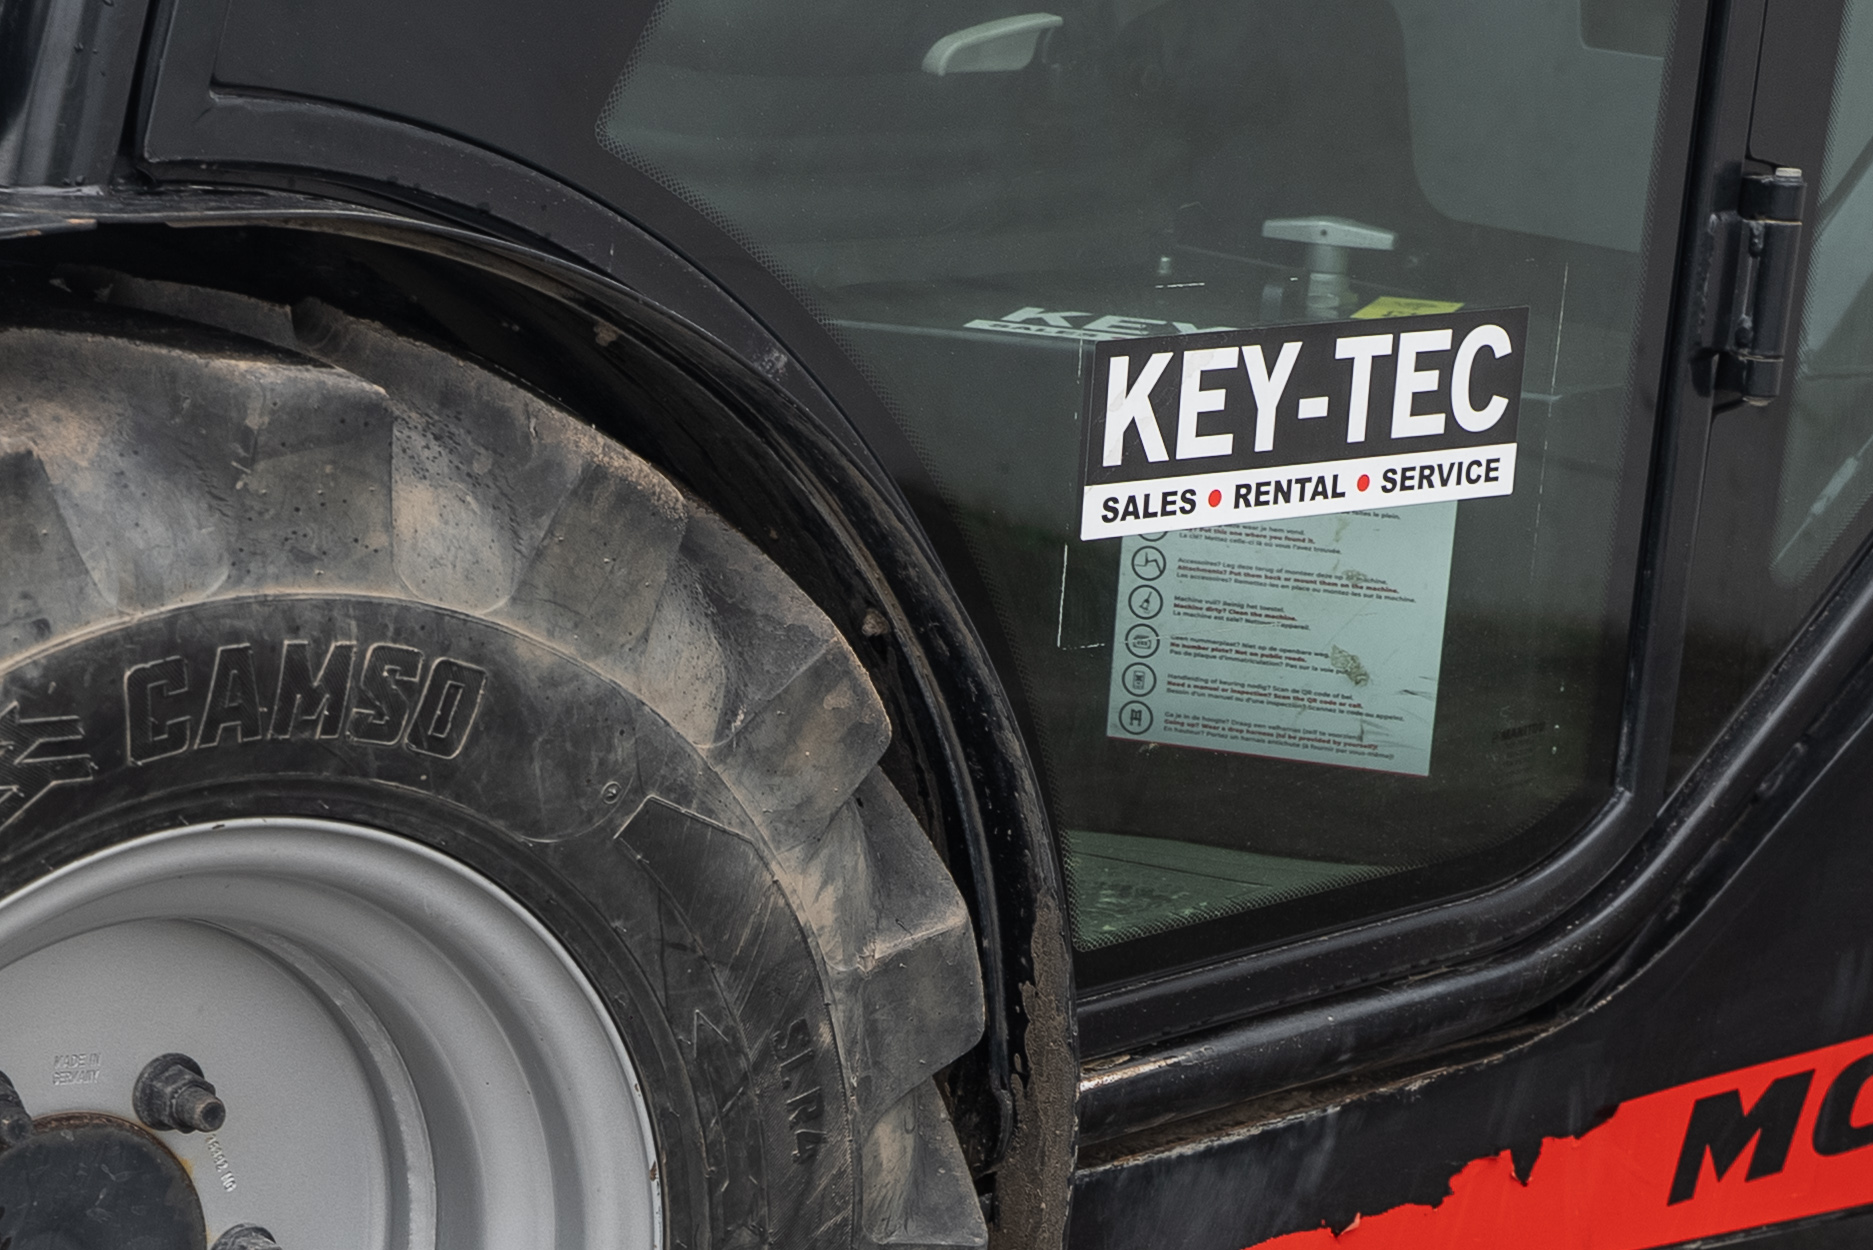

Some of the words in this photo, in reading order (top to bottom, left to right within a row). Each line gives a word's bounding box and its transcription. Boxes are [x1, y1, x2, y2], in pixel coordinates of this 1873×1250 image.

[1100, 323, 1514, 468] KEY-TEC
[1101, 487, 1198, 525] SALES
[1232, 472, 1348, 511] RENTAL
[1379, 455, 1502, 495] SERVICE
[122, 639, 488, 765] CAMSO
